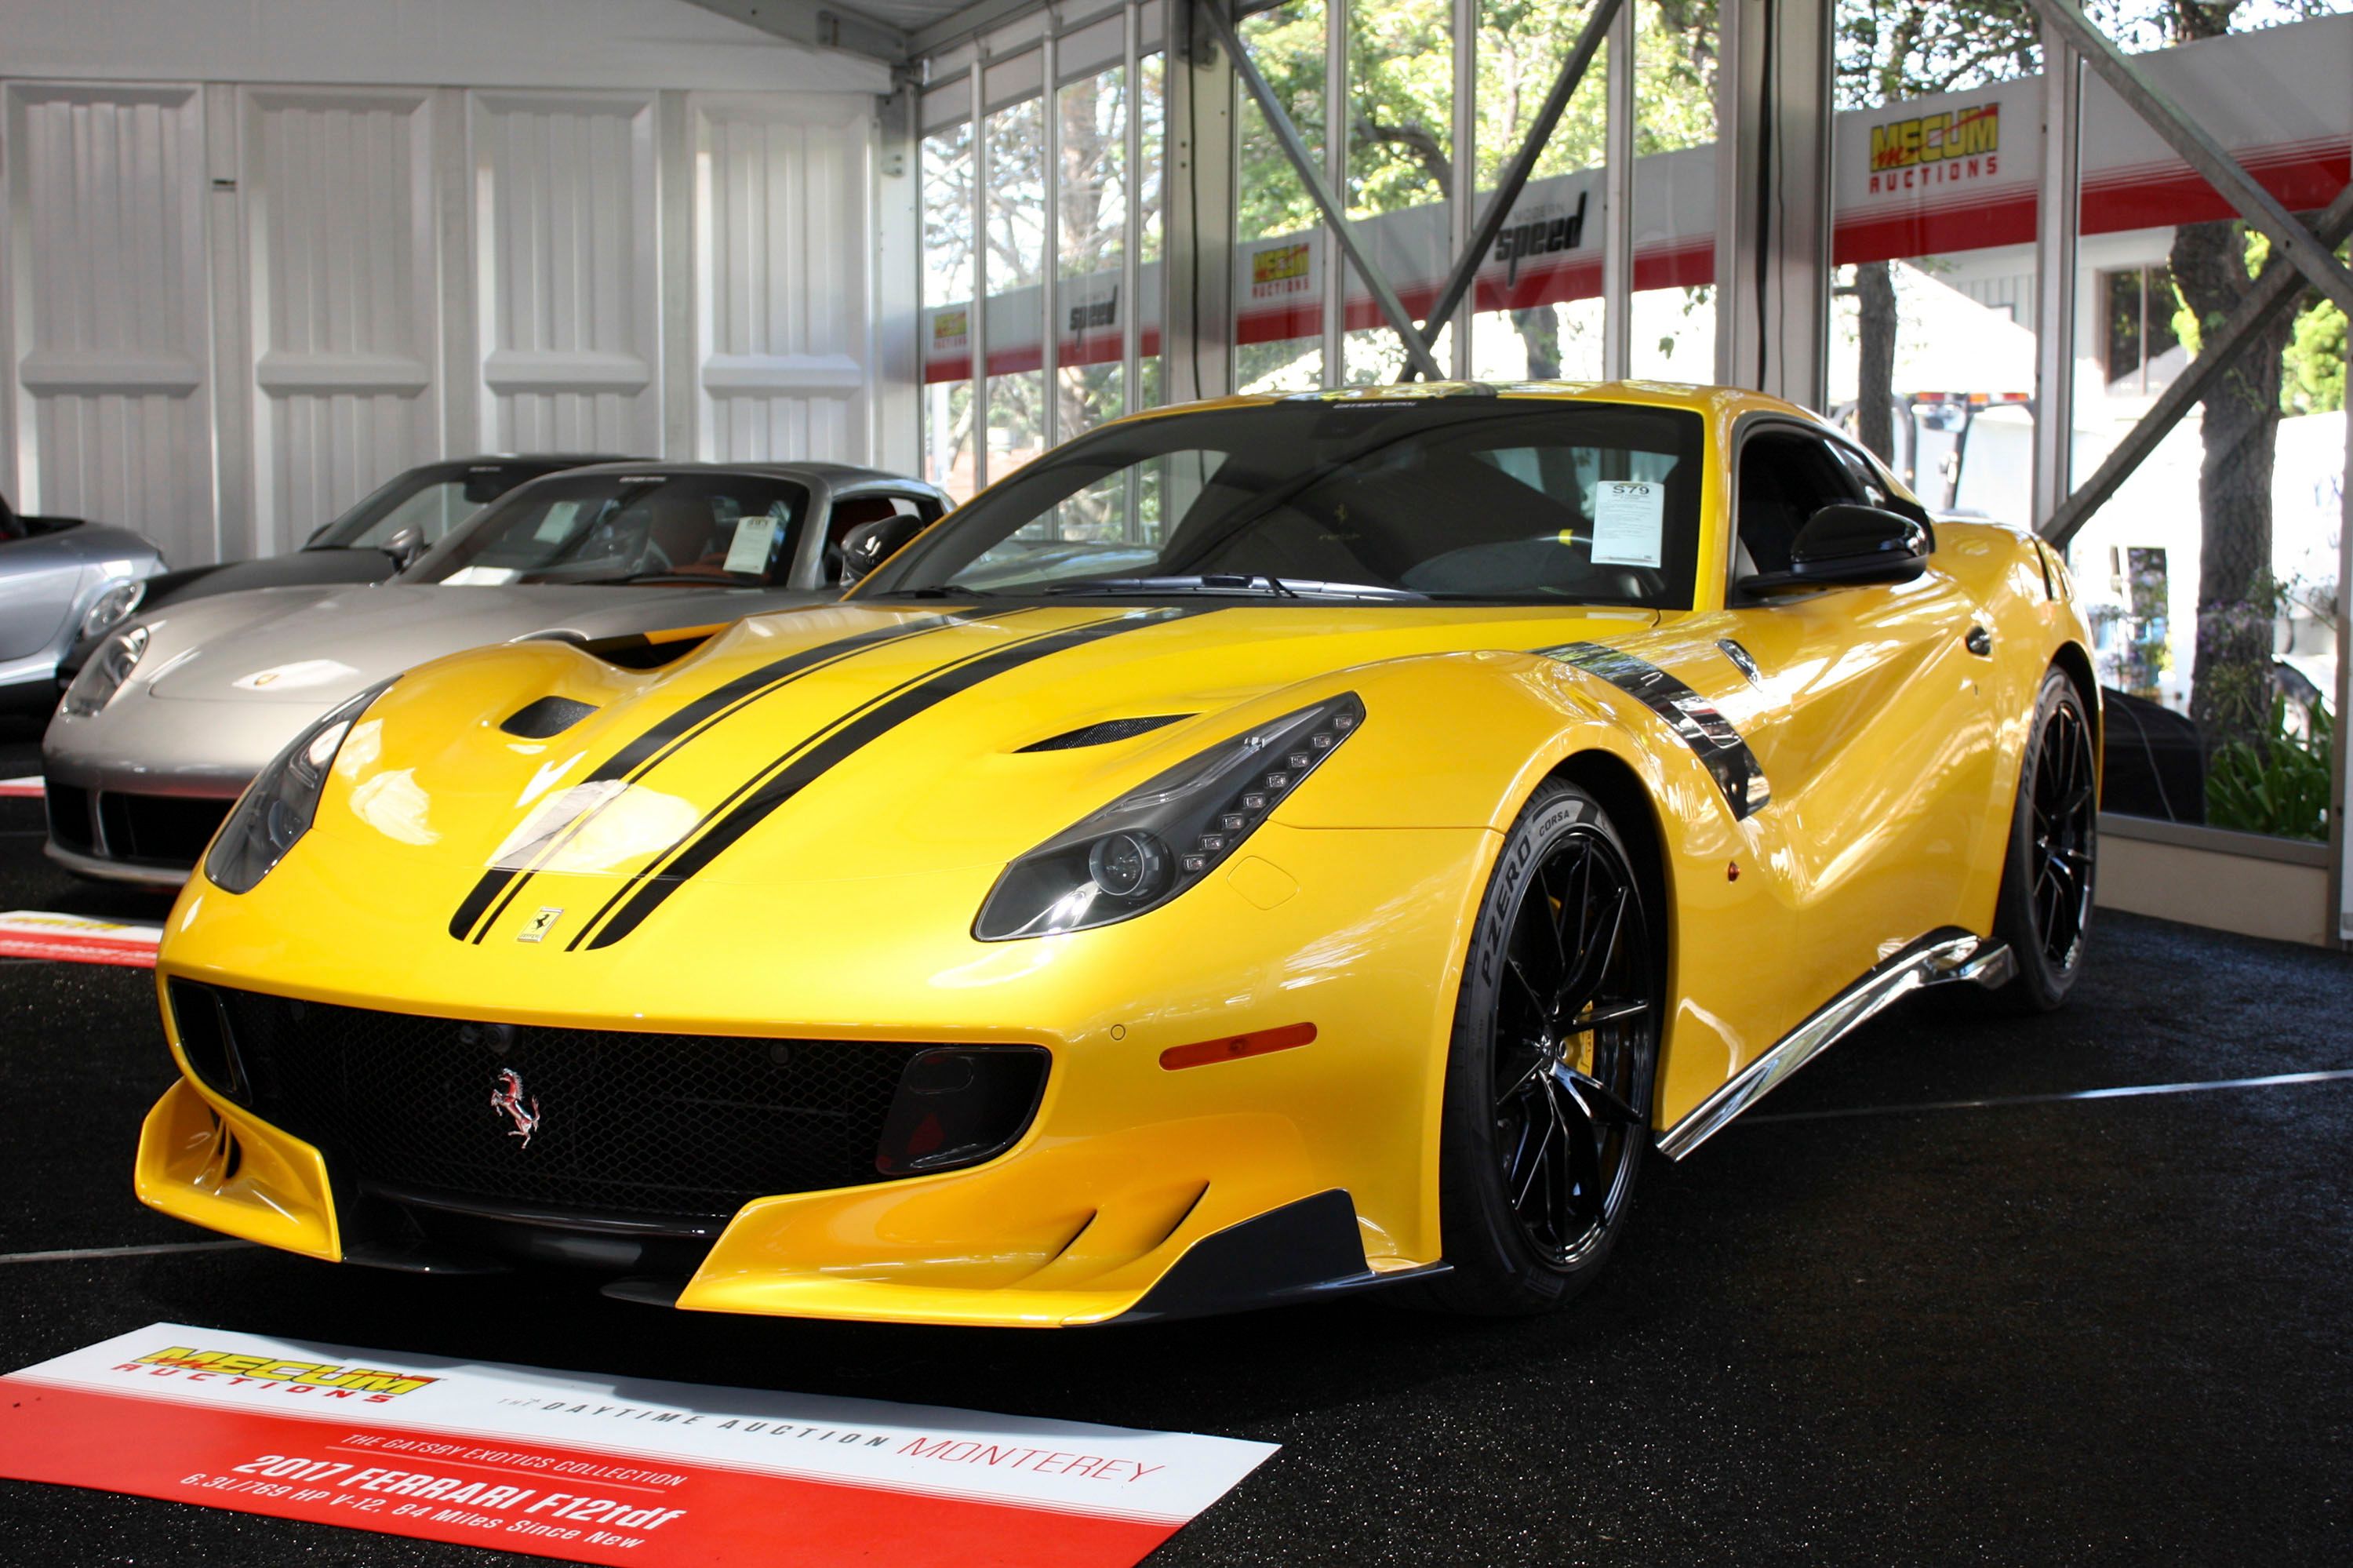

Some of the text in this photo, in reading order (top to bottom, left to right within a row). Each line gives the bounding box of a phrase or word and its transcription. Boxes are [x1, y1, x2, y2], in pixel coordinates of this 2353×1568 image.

[1871, 102, 2000, 173] MECUM
[1870, 156, 1998, 195] AUCTIONS
[1495, 191, 1587, 289] speed
[1613, 485, 1649, 495] S79
[1539, 809, 1569, 837] CORSA
[111, 1363, 395, 1402] AUCTIONS
[132, 1346, 440, 1395] MECUM
[341, 1434, 689, 1486] THE GATSBY EXOTICS COLLECTION
[541, 1402, 705, 1424] DAYTIME
[717, 1419, 889, 1447] AUCTION
[897, 1437, 1166, 1483] MONTEREY
[180, 1473, 646, 1548] 6.3L/769 HP V-12, 84 Miles Since New
[231, 1455, 688, 1530] 2017 FERRARI F12tdf
